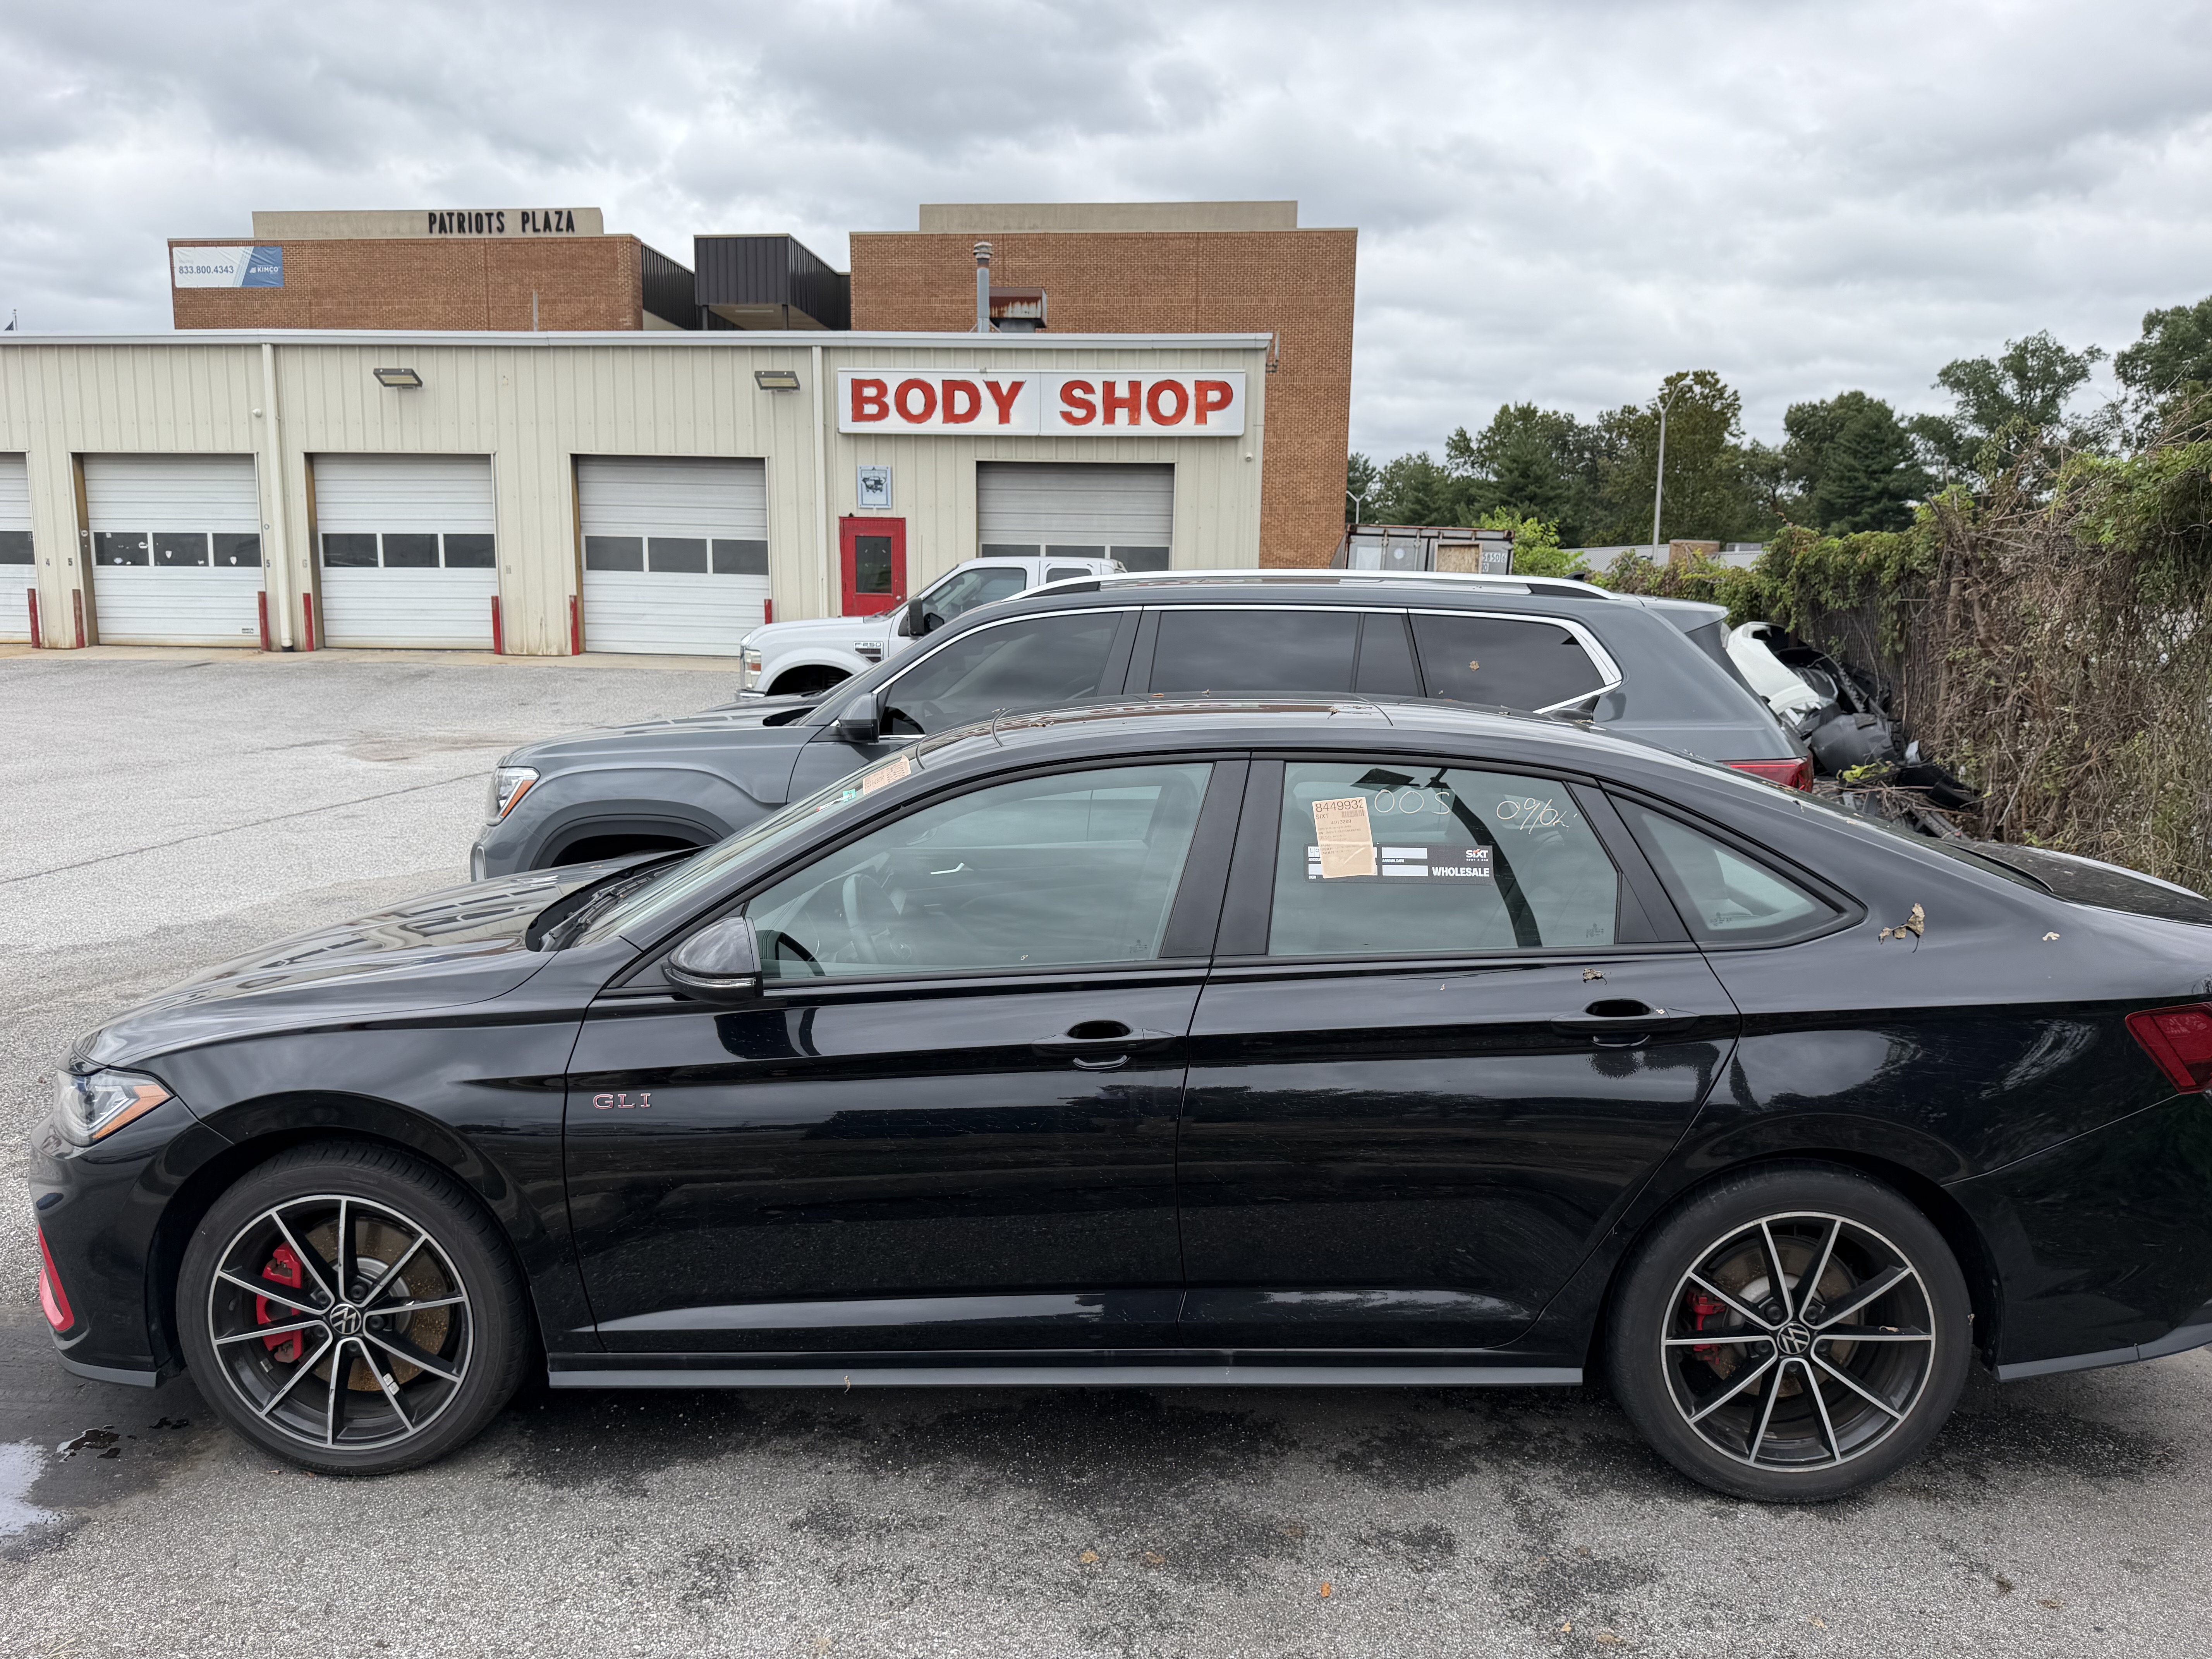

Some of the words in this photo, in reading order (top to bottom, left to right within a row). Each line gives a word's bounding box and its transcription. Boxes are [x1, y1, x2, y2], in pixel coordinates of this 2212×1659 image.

[428, 211, 505, 234] PATRIOTS
[521, 210, 575, 233] PLAZA
[179, 265, 234, 274] 833.800.4343
[851, 378, 1027, 424] BODY
[1059, 379, 1234, 426] SHOP
[266, 560, 270, 568] 5
[1316, 799, 1364, 812] 8449932
[1466, 849, 1488, 858] SIXT
[1432, 867, 1489, 877] WHOLESALE
[593, 1093, 651, 1109] GLI
